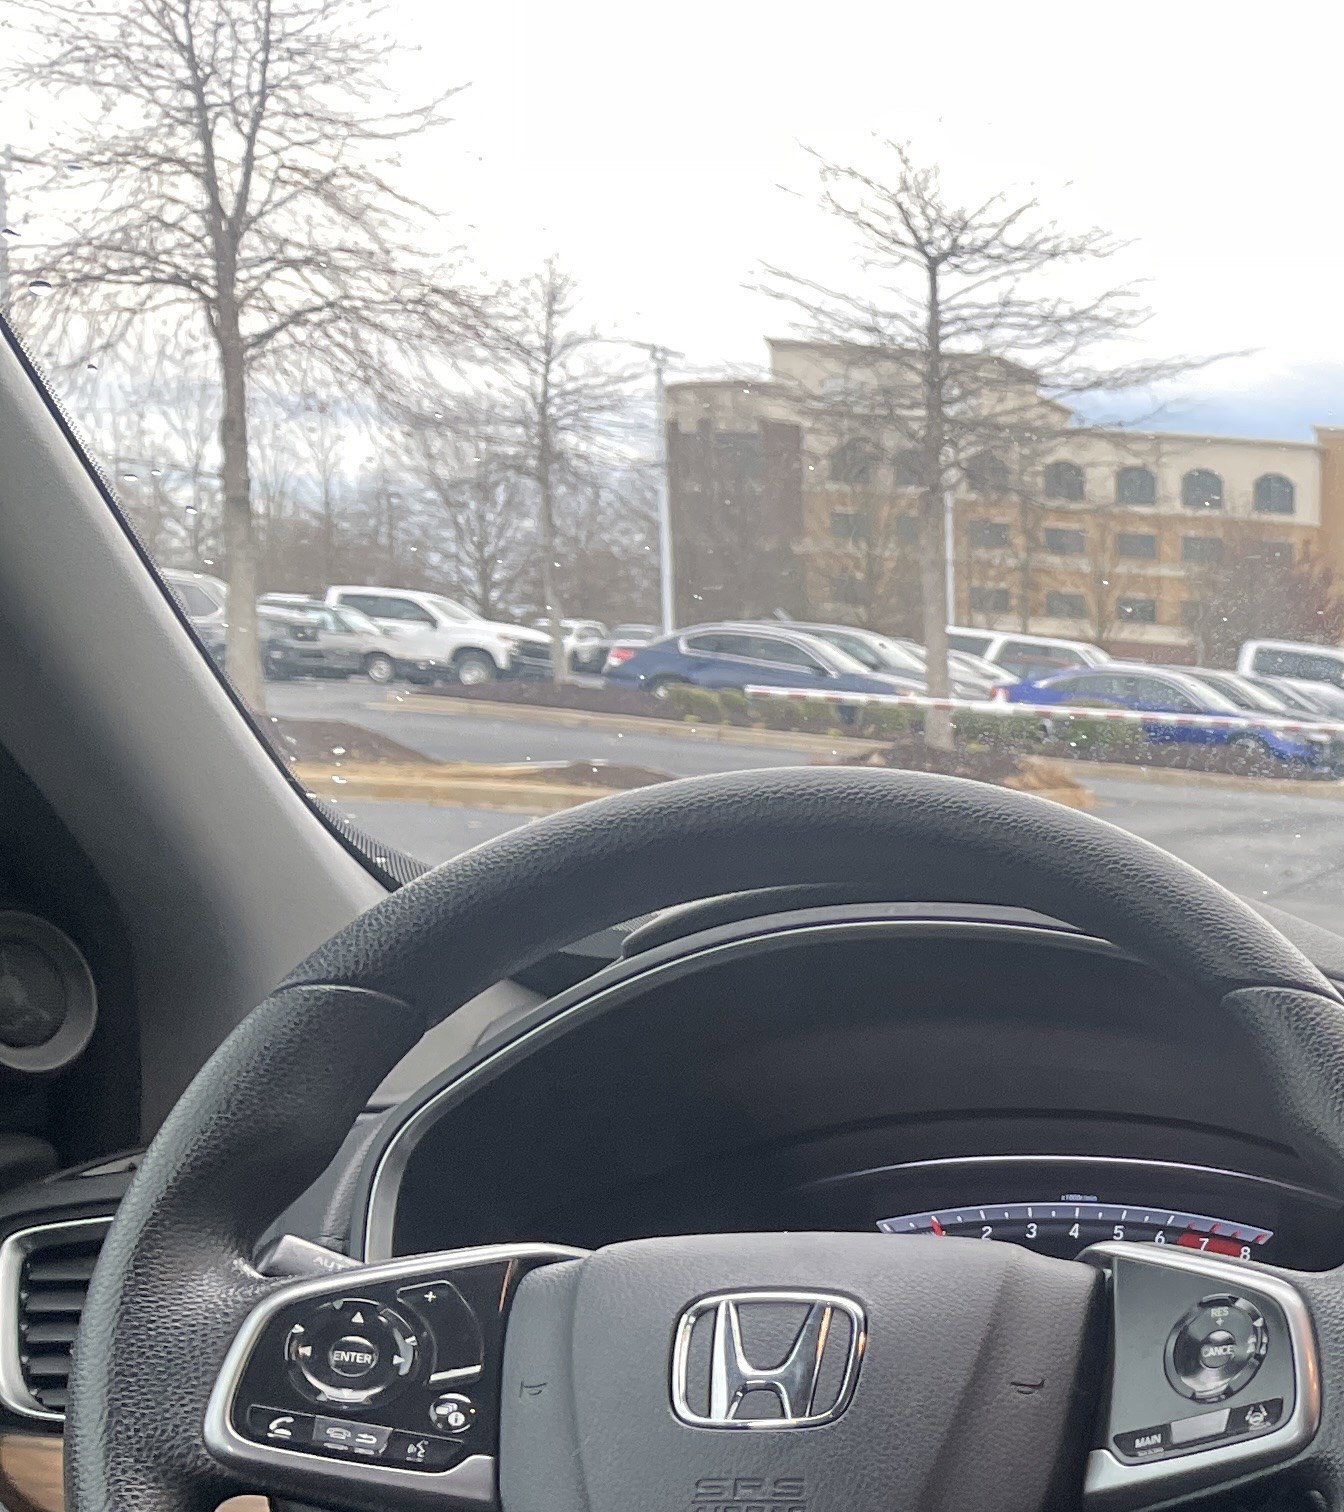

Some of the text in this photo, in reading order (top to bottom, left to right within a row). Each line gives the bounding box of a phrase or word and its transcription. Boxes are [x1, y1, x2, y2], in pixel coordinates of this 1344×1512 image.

[981, 1225, 993, 1240] 2
[1026, 1224, 1038, 1238] 3
[1068, 1224, 1080, 1238] 4
[1113, 1225, 1124, 1240] 5
[1154, 1230, 1166, 1245] 6
[1198, 1237, 1210, 1252] 7
[1239, 1246, 1251, 1262] 8
[332, 1351, 373, 1366] ENTER
[693, 1477, 805, 1500] SRS
